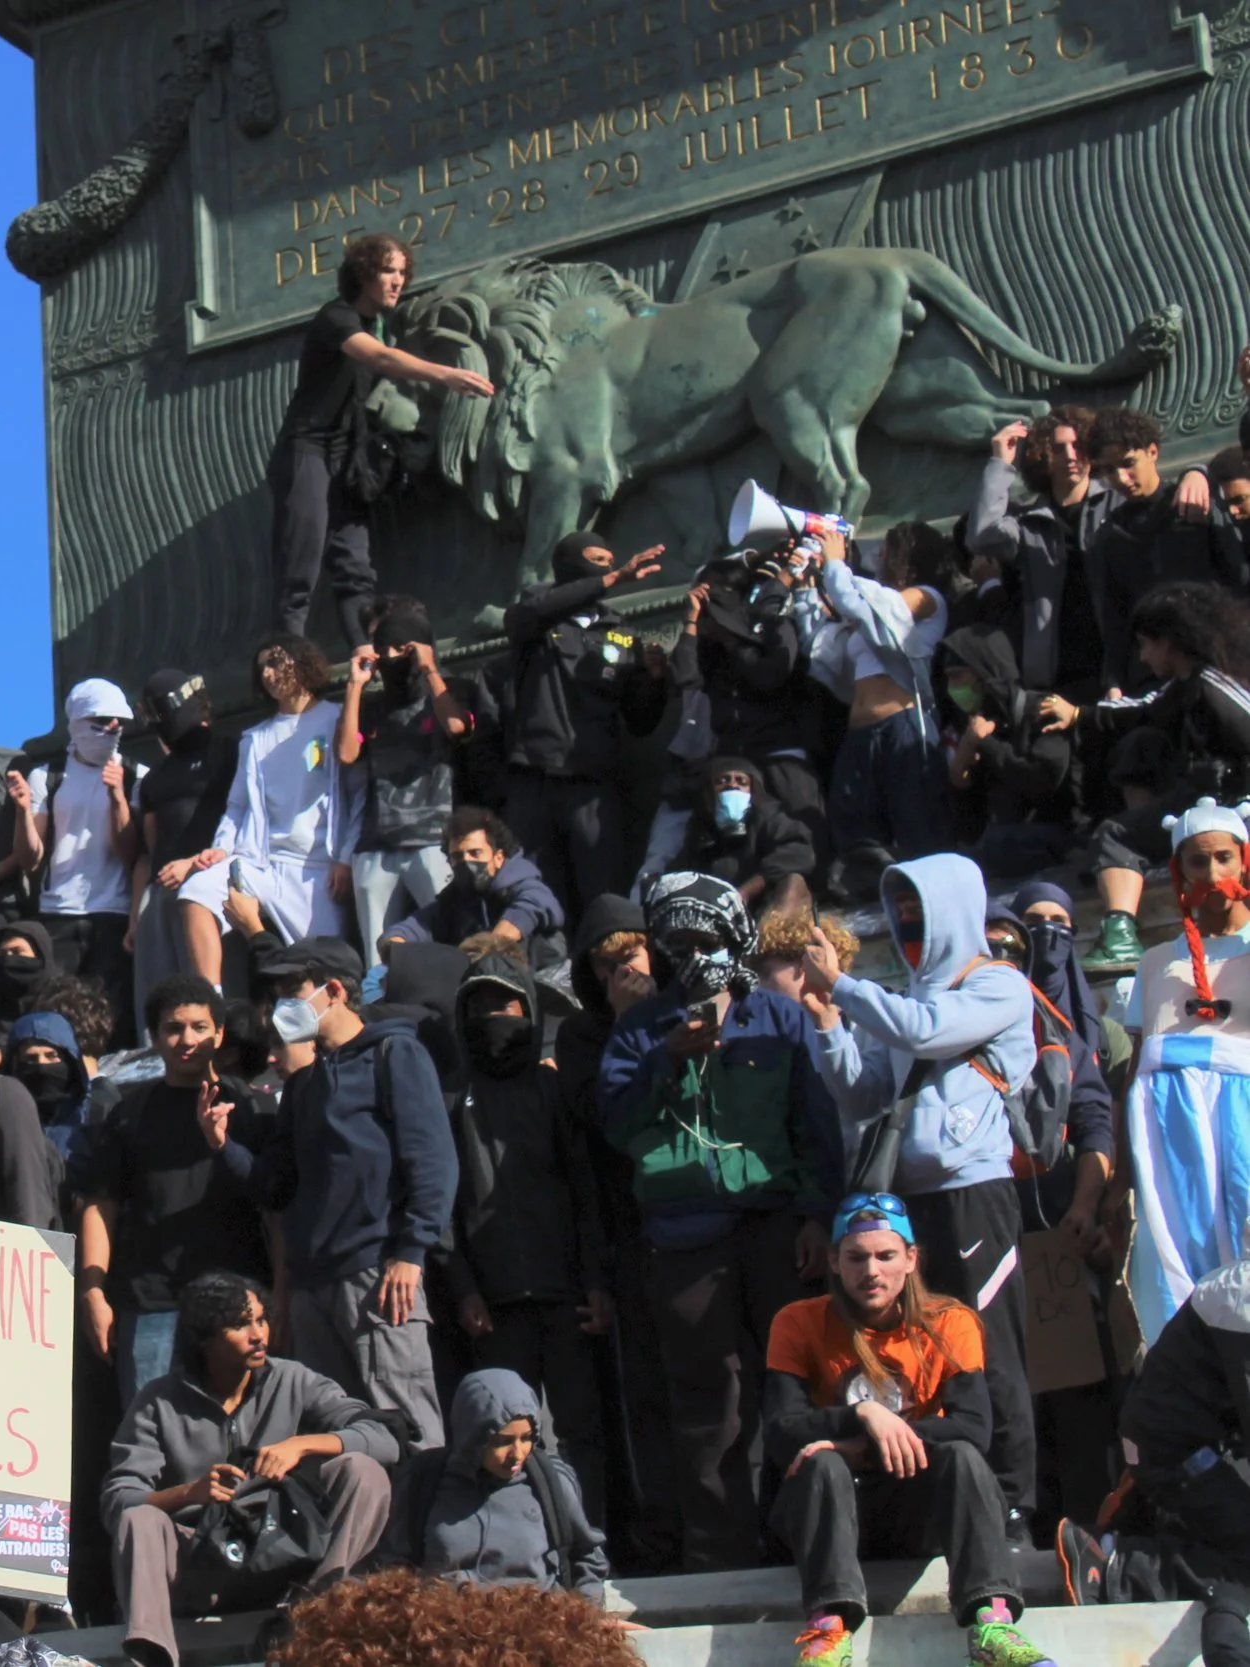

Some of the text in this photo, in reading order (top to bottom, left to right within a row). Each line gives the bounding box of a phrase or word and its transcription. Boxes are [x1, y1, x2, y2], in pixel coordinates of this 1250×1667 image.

[291, 176, 403, 232] DANS
[416, 144, 492, 196] LES
[507, 53, 806, 171] MEMORABLES
[397, 199, 459, 249] 27
[486, 177, 547, 228] 28
[583, 151, 640, 200] 29
[678, 79, 883, 172] JUILLET
[8, 1520, 65, 1542] PAS LES
